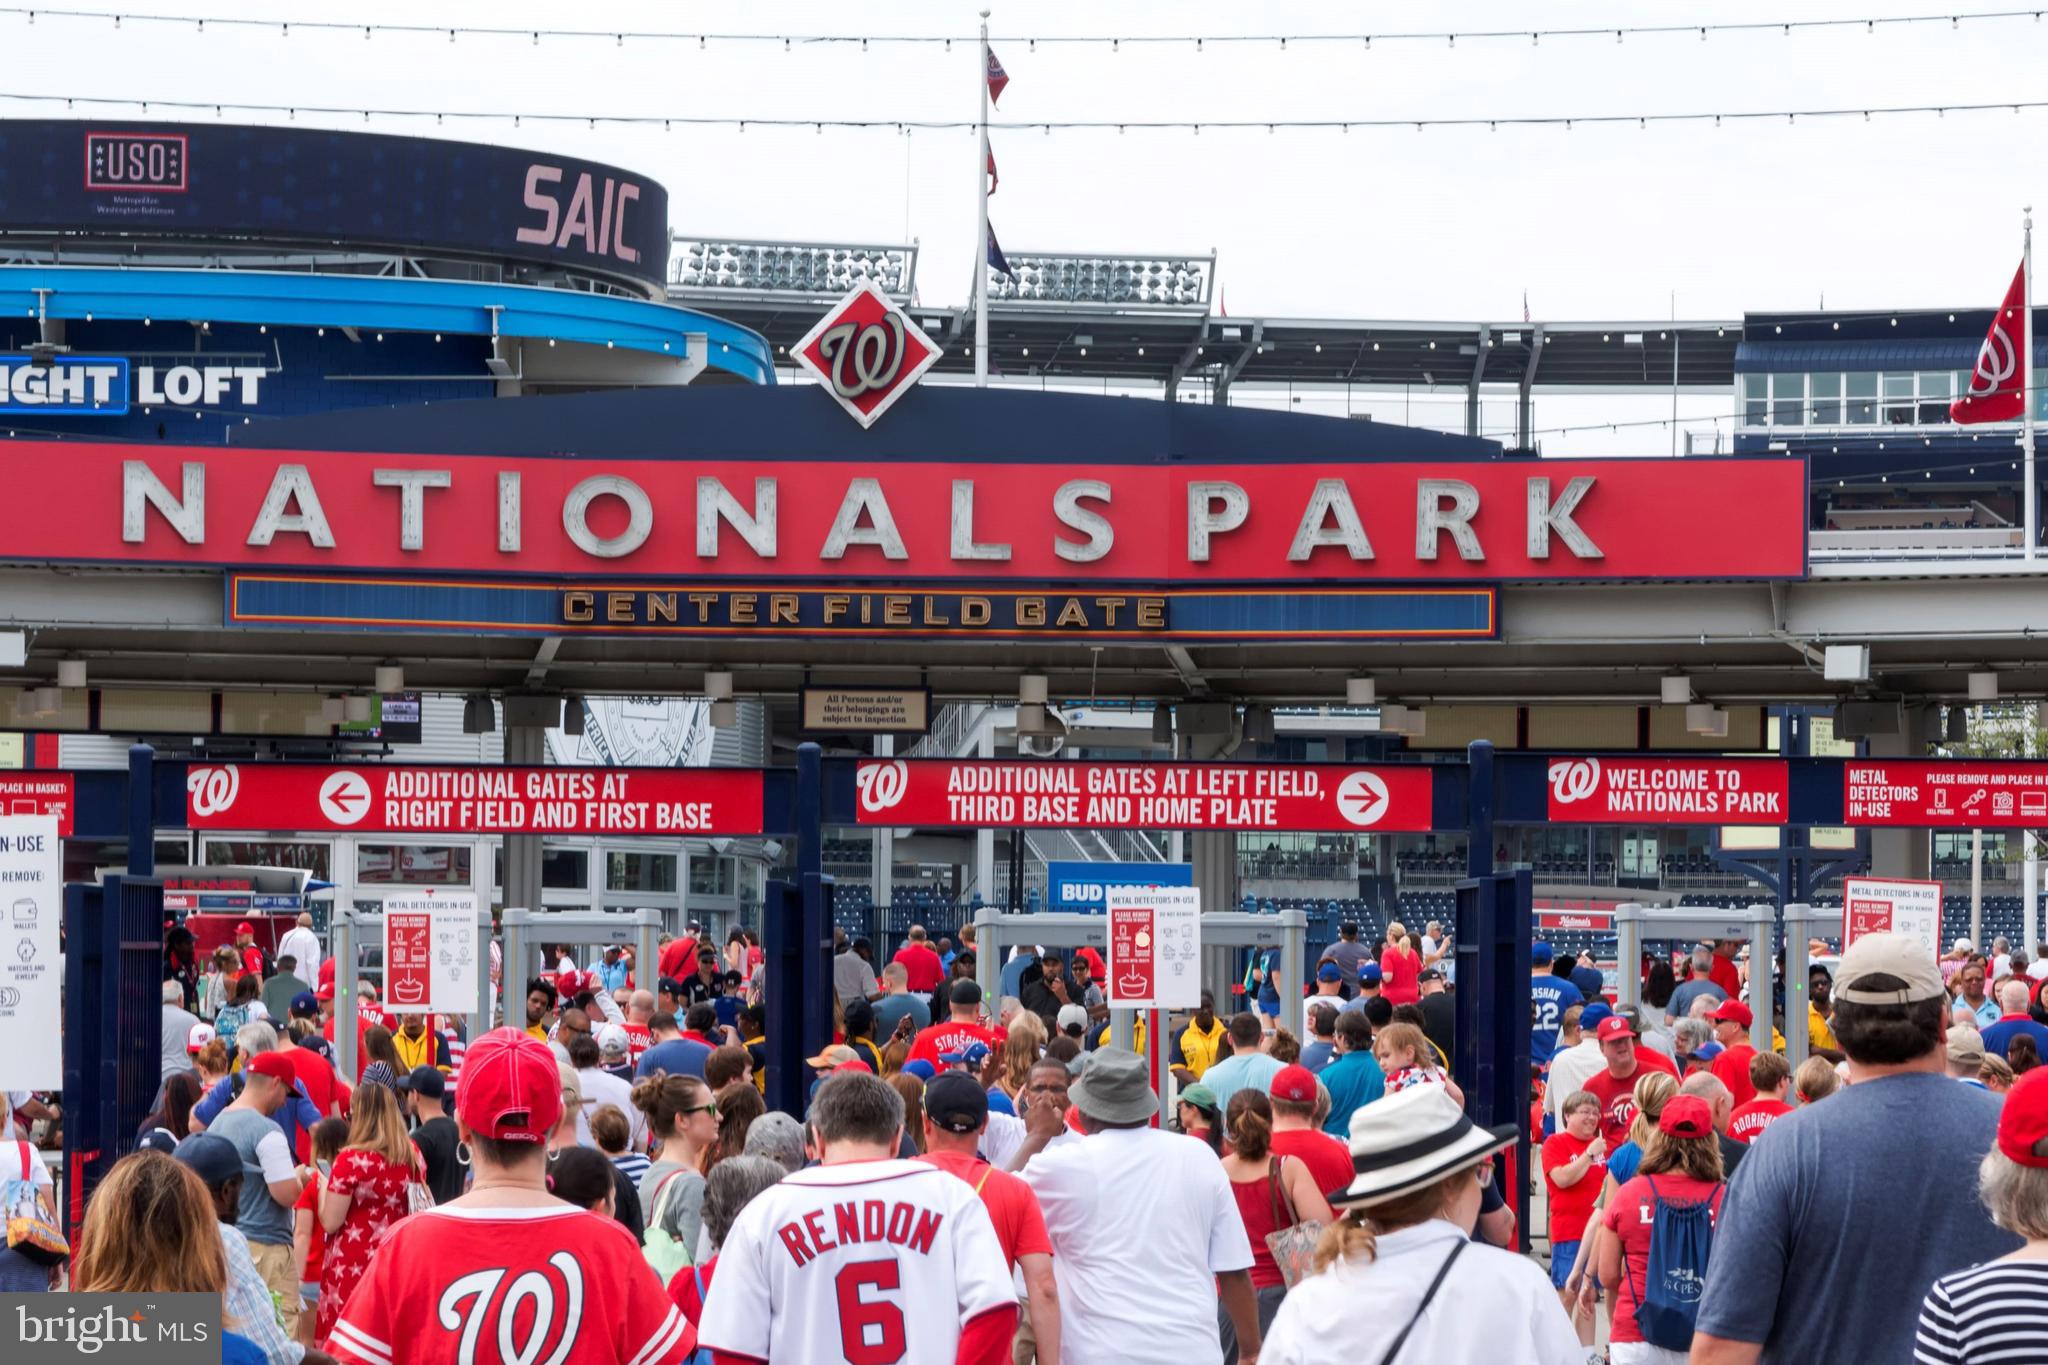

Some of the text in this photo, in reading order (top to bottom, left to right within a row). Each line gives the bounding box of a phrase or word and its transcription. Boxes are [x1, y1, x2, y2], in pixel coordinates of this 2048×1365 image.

[108, 142, 165, 181] USO
[516, 163, 640, 263] SAIC
[138, 365, 266, 405] LOFT
[122, 459, 1606, 563] NATIONALS PARK
[563, 590, 1166, 628] CENTER FIELD GATE
[826, 694, 903, 703] All Persons and/or
[822, 715, 851, 725] subject
[864, 715, 906, 725] inspection
[824, 705, 843, 714] their
[846, 705, 890, 715] belongings
[385, 771, 629, 800] ADDITIONAL GATES AT
[948, 766, 1325, 801] ADDITIONAL GATES AT LEFT FIELD,
[1607, 768, 1740, 791] WELCOME TO
[1849, 769, 1888, 785] METAL
[1926, 773, 1956, 785] PLEASE
[1957, 773, 1989, 785] REMOVE
[1991, 774, 2007, 785] AND
[2008, 774, 2033, 786] PLACE
[2035, 775, 2044, 786] IN
[26, 783, 34, 795] IN
[1849, 786, 1919, 802] DETECTORS
[949, 795, 1278, 826] THIRD BASE AND HOME PLATE
[1607, 790, 1780, 814] NATIONALS PARK
[1849, 802, 1892, 817] IN-USE
[385, 800, 713, 830] RIGHT FIELD AND FIRST BASE
[1062, 884, 1103, 901] BUD
[1112, 897, 1132, 905] METAL
[1134, 897, 1172, 905] DETECTORS
[1851, 887, 1872, 896] METAL
[1874, 888, 1911, 898] DETECTORS
[8, 964, 33, 973] WATCHES
[503, 1132, 538, 1141] GEICO
[777, 1199, 944, 1268] RENDON
[835, 1259, 907, 1365] 6
